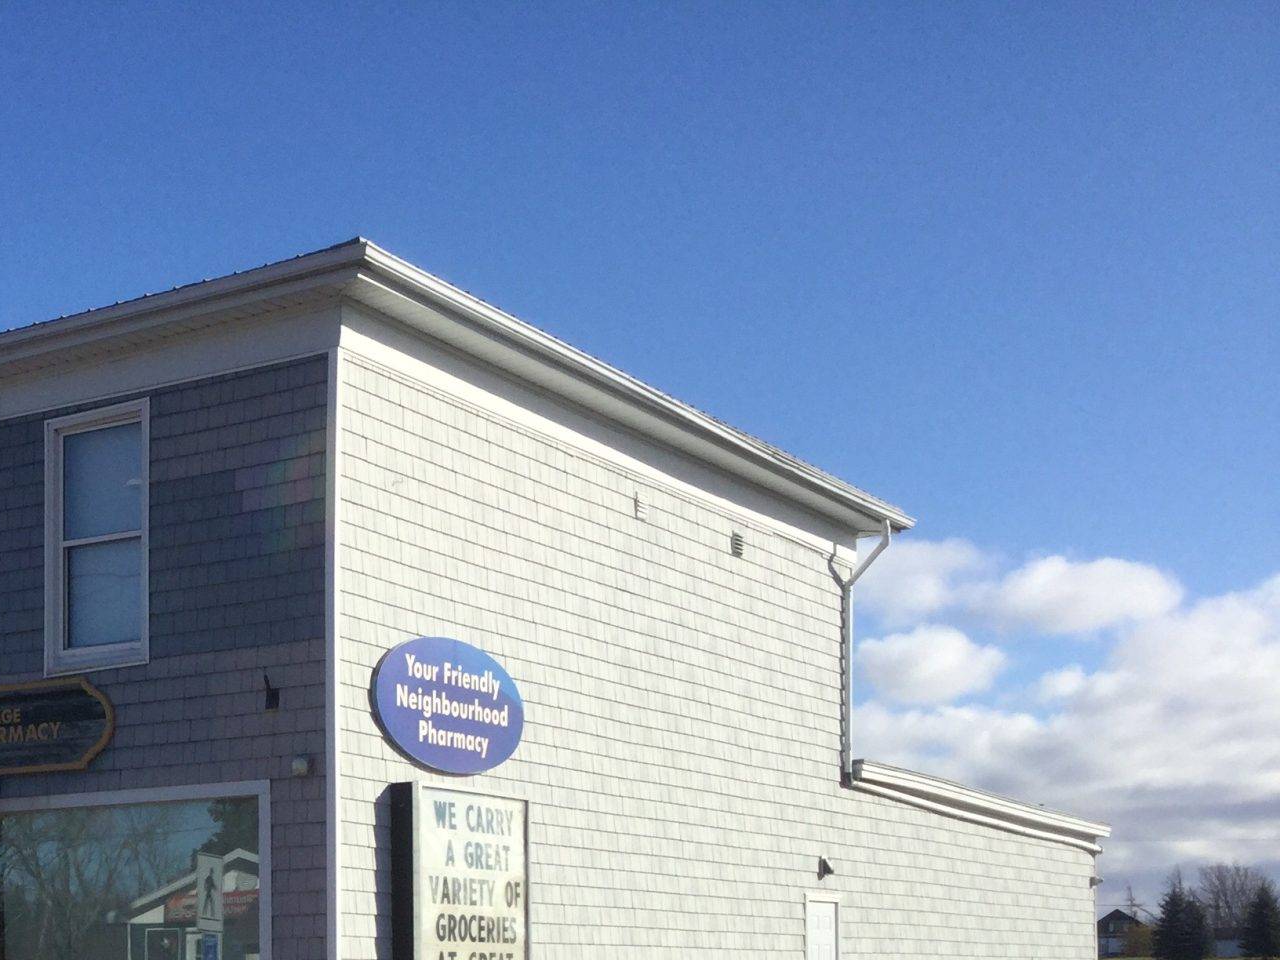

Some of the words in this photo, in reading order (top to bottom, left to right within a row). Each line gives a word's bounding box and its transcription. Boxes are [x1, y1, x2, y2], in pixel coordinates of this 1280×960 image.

[405, 653, 439, 681] Your
[444, 662, 500, 700] Friendly
[396, 684, 508, 727] Neighbourhood
[419, 720, 489, 758] Pharmacy
[433, 800, 457, 830] WE
[466, 805, 514, 837] CARRY
[445, 839, 455, 867] A
[464, 841, 510, 873] GREAT
[429, 875, 496, 907] VARIETY
[504, 880, 521, 908] OF
[435, 913, 517, 945] GROCERIES
